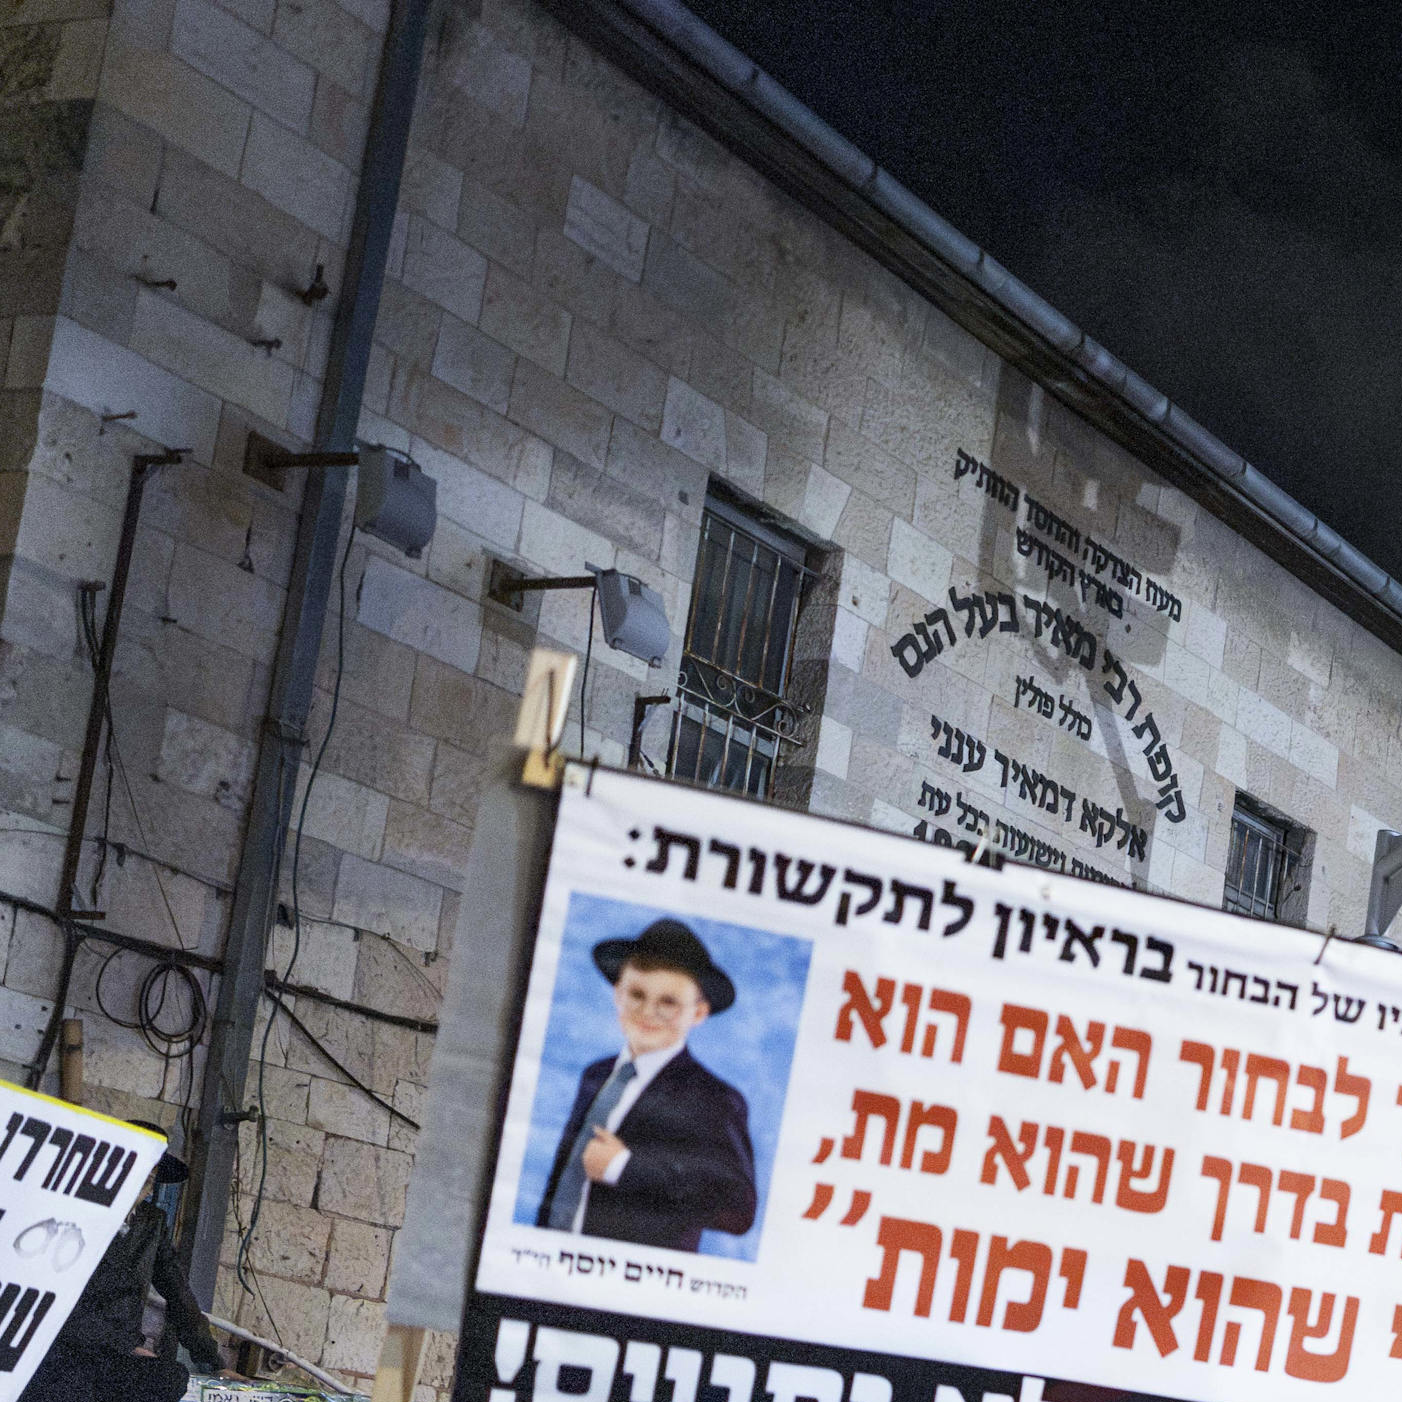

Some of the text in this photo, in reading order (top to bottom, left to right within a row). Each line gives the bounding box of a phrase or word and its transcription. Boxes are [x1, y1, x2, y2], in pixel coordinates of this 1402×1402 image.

[1015, 526, 1076, 587] הקודש
[890, 586, 1187, 824] קופת רבי מאיר בעל הנס
[917, 779, 952, 817] עת
[930, 714, 1148, 863] אלקא דמאיר ענני
[623, 823, 975, 938] לתקשורת:
[992, 901, 1176, 983] בראיון
[1186, 956, 1300, 1011] הבחור
[834, 969, 973, 1067] הוא
[1311, 981, 1366, 1025] של
[997, 1001, 1154, 1102] האם
[1179, 1037, 1373, 1142] לבחור
[811, 1088, 960, 1178] מת,
[979, 1113, 1177, 1215] שהוא
[1200, 1154, 1351, 1250] בדרך
[558, 1250, 617, 1277] יוסף
[623, 1260, 685, 1290] חיים
[1111, 1258, 1361, 1385] שהוא
